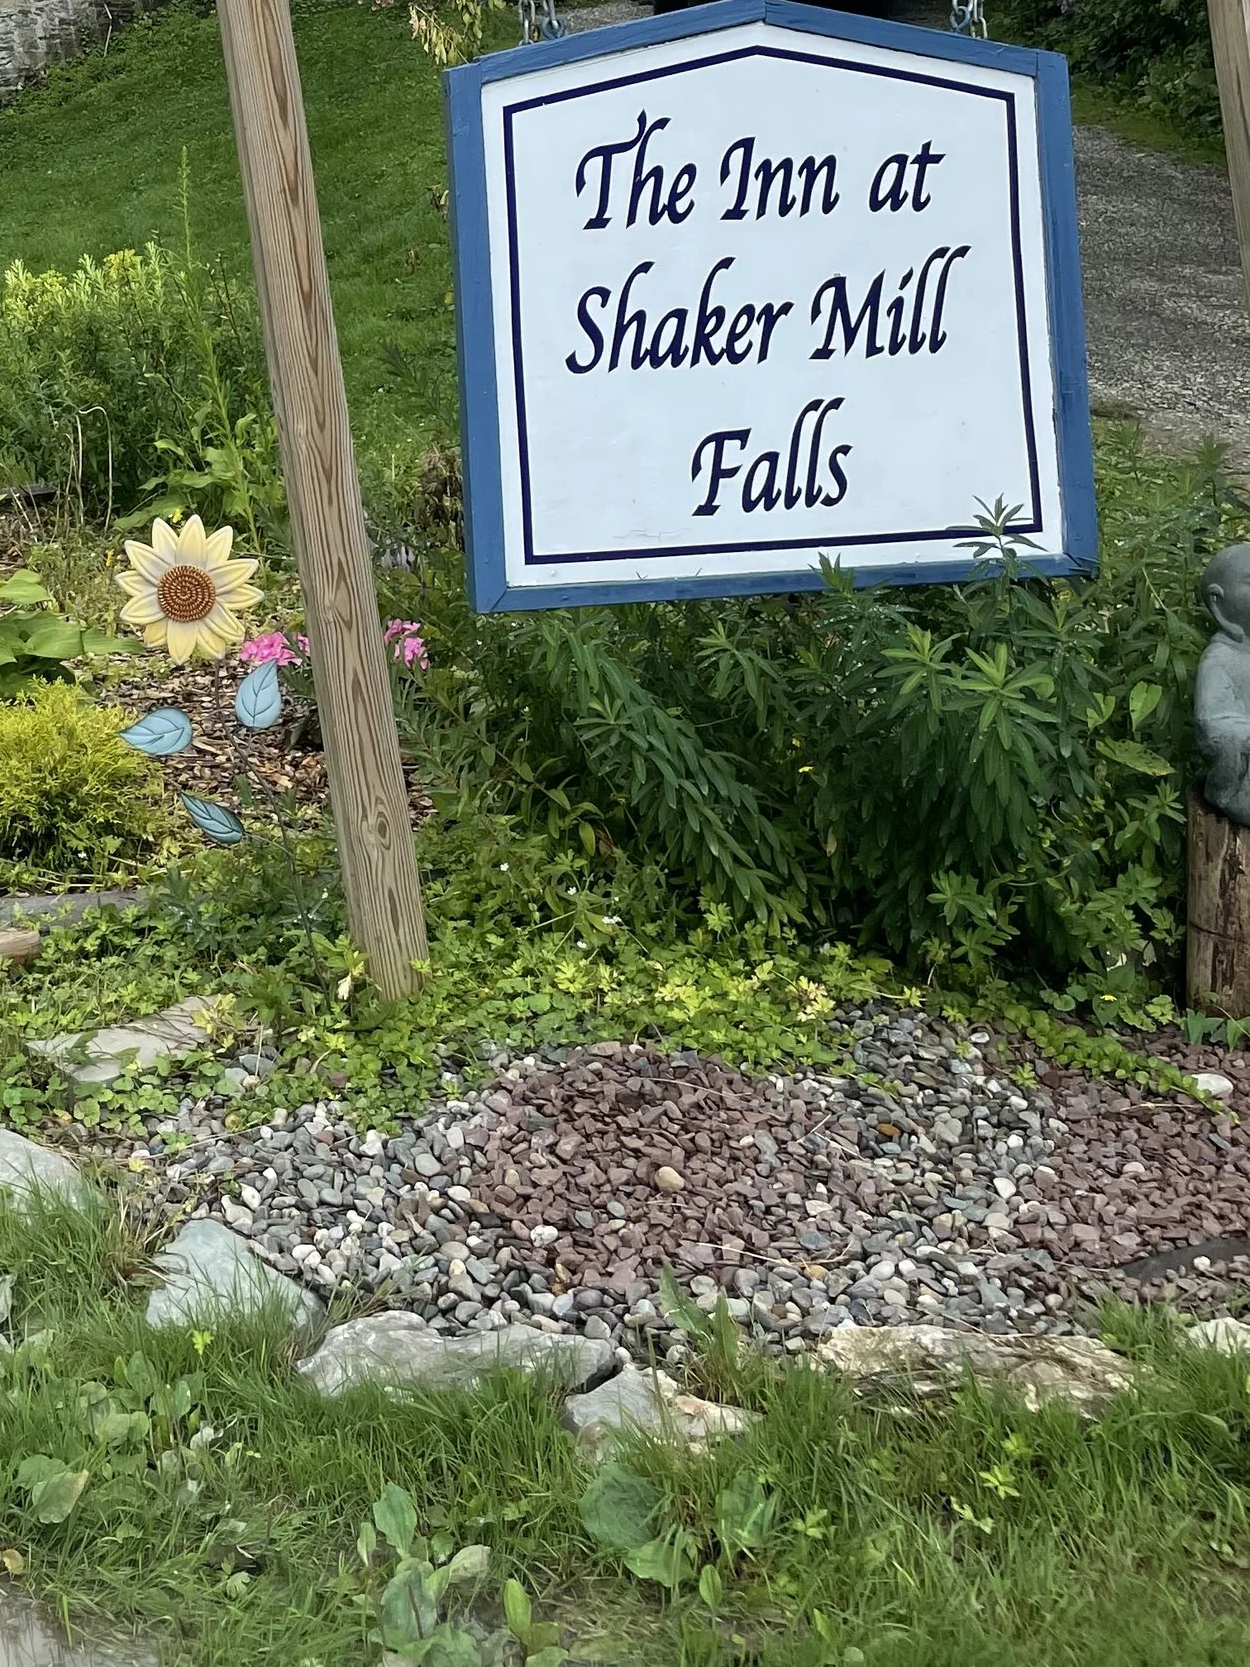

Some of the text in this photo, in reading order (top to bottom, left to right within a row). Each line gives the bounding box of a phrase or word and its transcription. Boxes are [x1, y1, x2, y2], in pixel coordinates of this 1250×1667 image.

[575, 108, 947, 231] The Inn at
[564, 245, 972, 375] Shaker Mill
[691, 396, 853, 517] Falls
